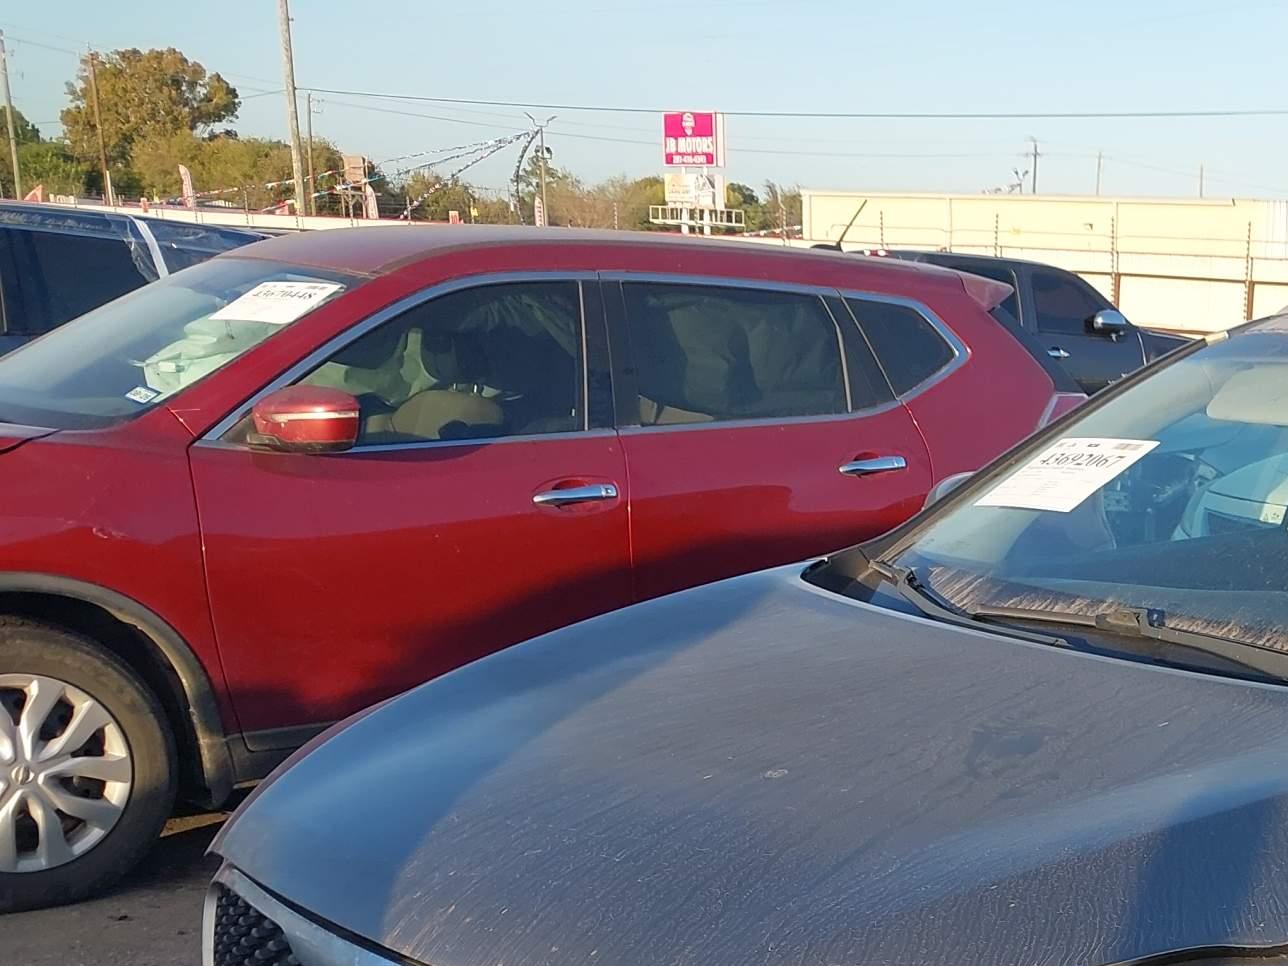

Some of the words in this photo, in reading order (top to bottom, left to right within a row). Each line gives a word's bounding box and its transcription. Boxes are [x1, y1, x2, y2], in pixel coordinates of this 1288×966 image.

[666, 137, 677, 153] JB
[678, 136, 714, 153] MOTORS
[1040, 451, 1127, 468] 43692067
